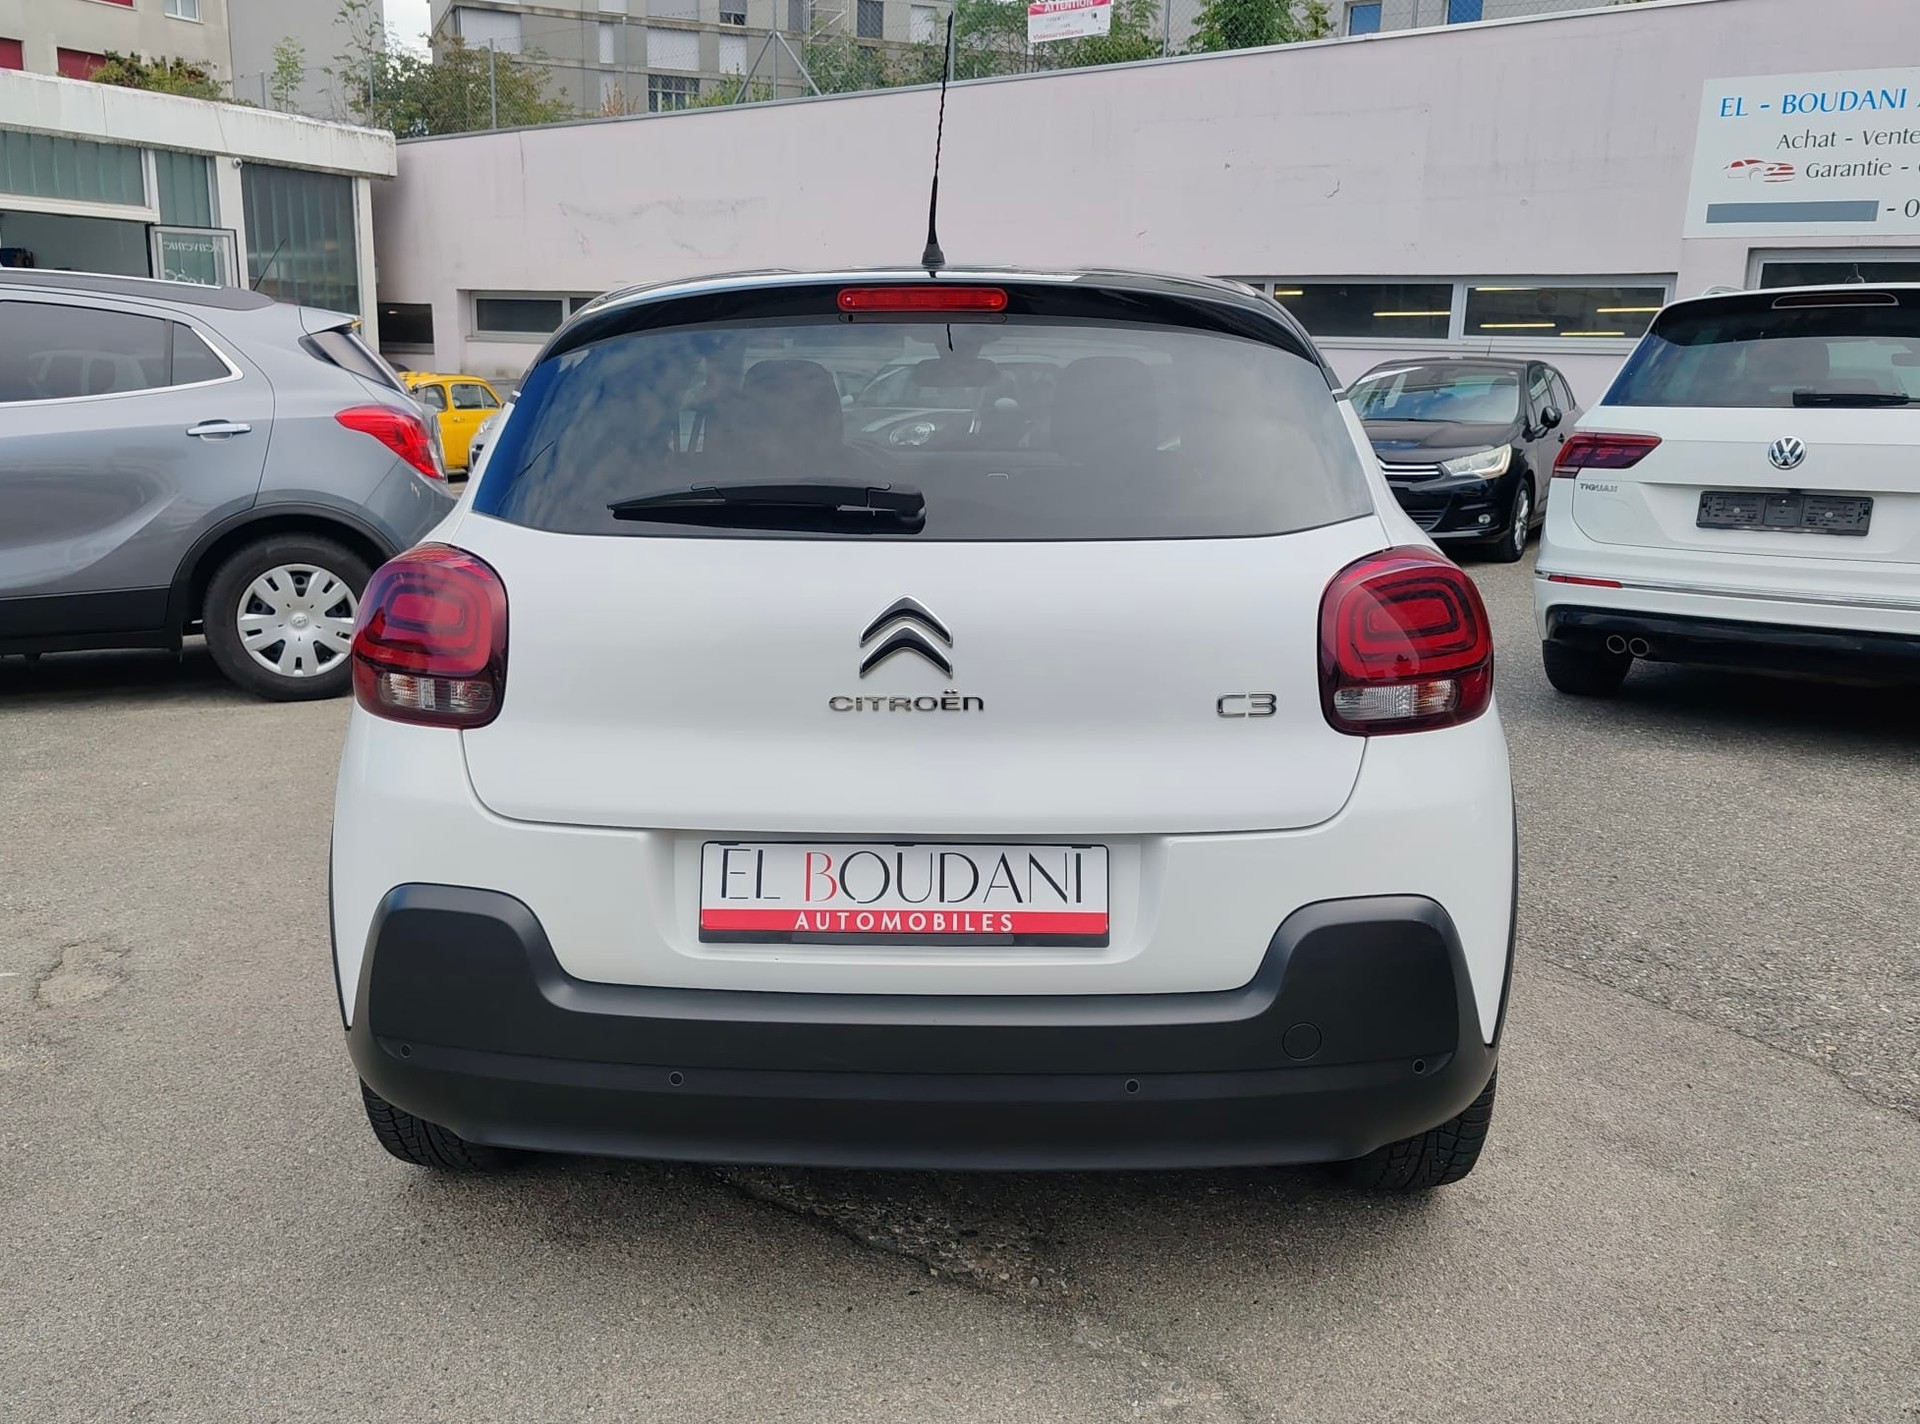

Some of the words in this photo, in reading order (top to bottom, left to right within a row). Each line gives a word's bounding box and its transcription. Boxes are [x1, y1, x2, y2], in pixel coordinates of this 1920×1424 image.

[1044, 0, 1094, 13] ATTENTION
[1719, 96, 1749, 118] EL
[1781, 88, 1908, 115] BOUDANI
[1776, 128, 1837, 150] Achat
[1862, 127, 1920, 146] Vente
[1805, 157, 1893, 179] Garantie
[1216, 691, 1277, 718] C3
[720, 847, 781, 900] EL
[804, 849, 1084, 904] BOUDANI
[794, 910, 1014, 932] AUTOMOBILES
